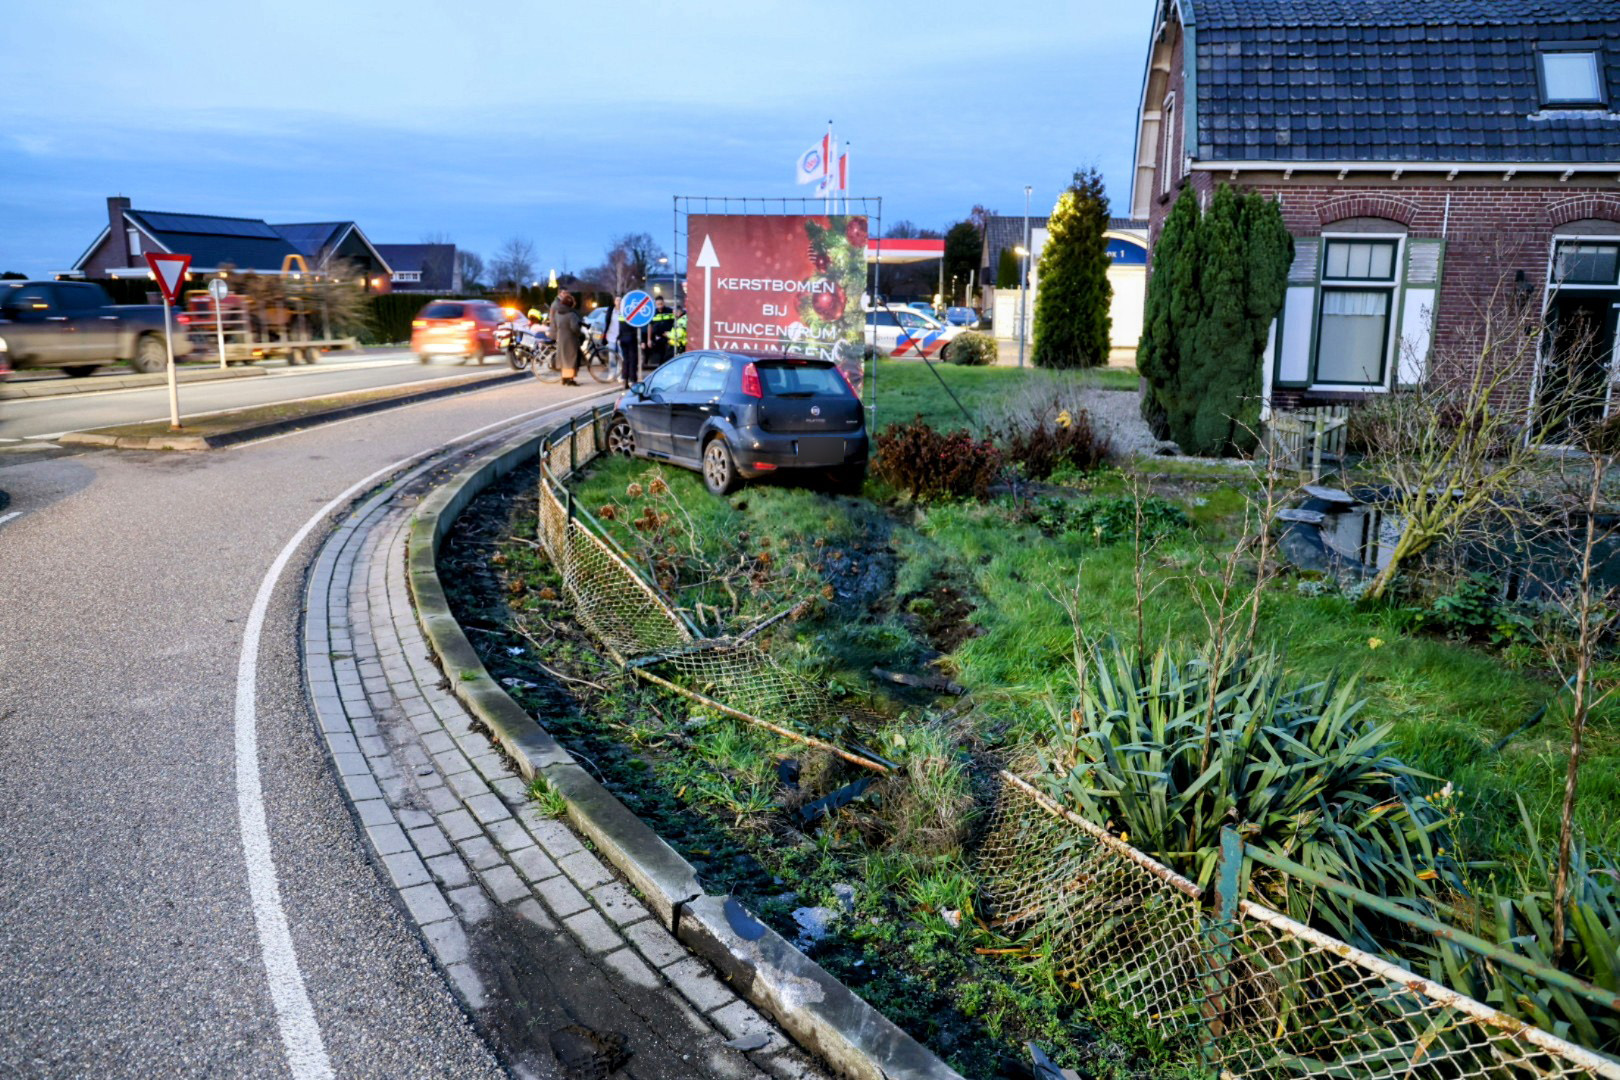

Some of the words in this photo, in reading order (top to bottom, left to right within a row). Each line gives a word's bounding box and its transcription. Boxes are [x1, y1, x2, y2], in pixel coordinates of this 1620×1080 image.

[717, 278, 835, 294] KERSTBOMEN
[762, 304, 788, 317] BIJ
[714, 321, 837, 340] TUINCENTRUM
